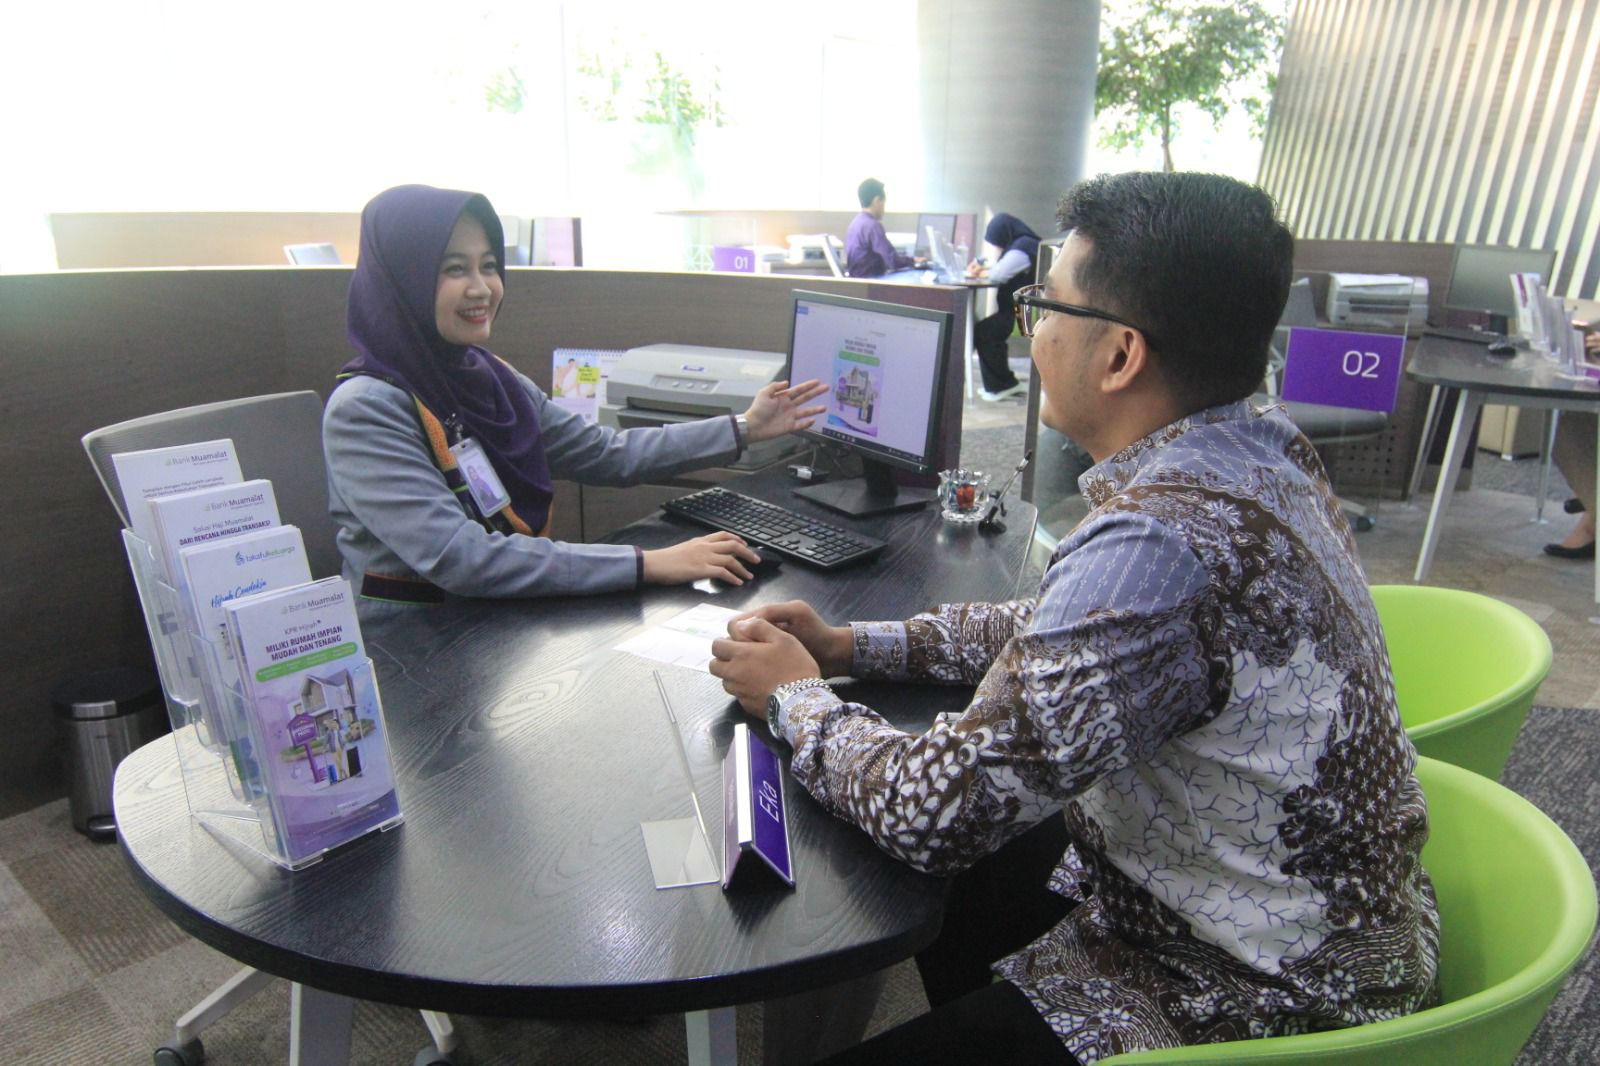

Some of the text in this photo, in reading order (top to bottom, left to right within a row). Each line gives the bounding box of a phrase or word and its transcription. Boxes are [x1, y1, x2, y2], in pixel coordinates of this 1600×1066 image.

[734, 256, 748, 270] 01
[1342, 350, 1380, 378] 02
[172, 456, 190, 465] Bank
[191, 451, 227, 462] Muamalat
[211, 502, 228, 510] Bank
[228, 494, 264, 506] Muamalat
[224, 516, 254, 526] Muamalat
[180, 520, 271, 546] DARI RENCANA HINGGA TRANSAKSI
[289, 604, 307, 612] Bank
[308, 593, 344, 606] Muamalat
[266, 625, 343, 654] MILIKI RUMAH IMPIAN
[284, 627, 298, 635] KPR
[272, 649, 299, 662] MUDAH
[300, 643, 314, 653] DAN
[315, 635, 342, 648] TENANG
[759, 780, 780, 823] Eka
